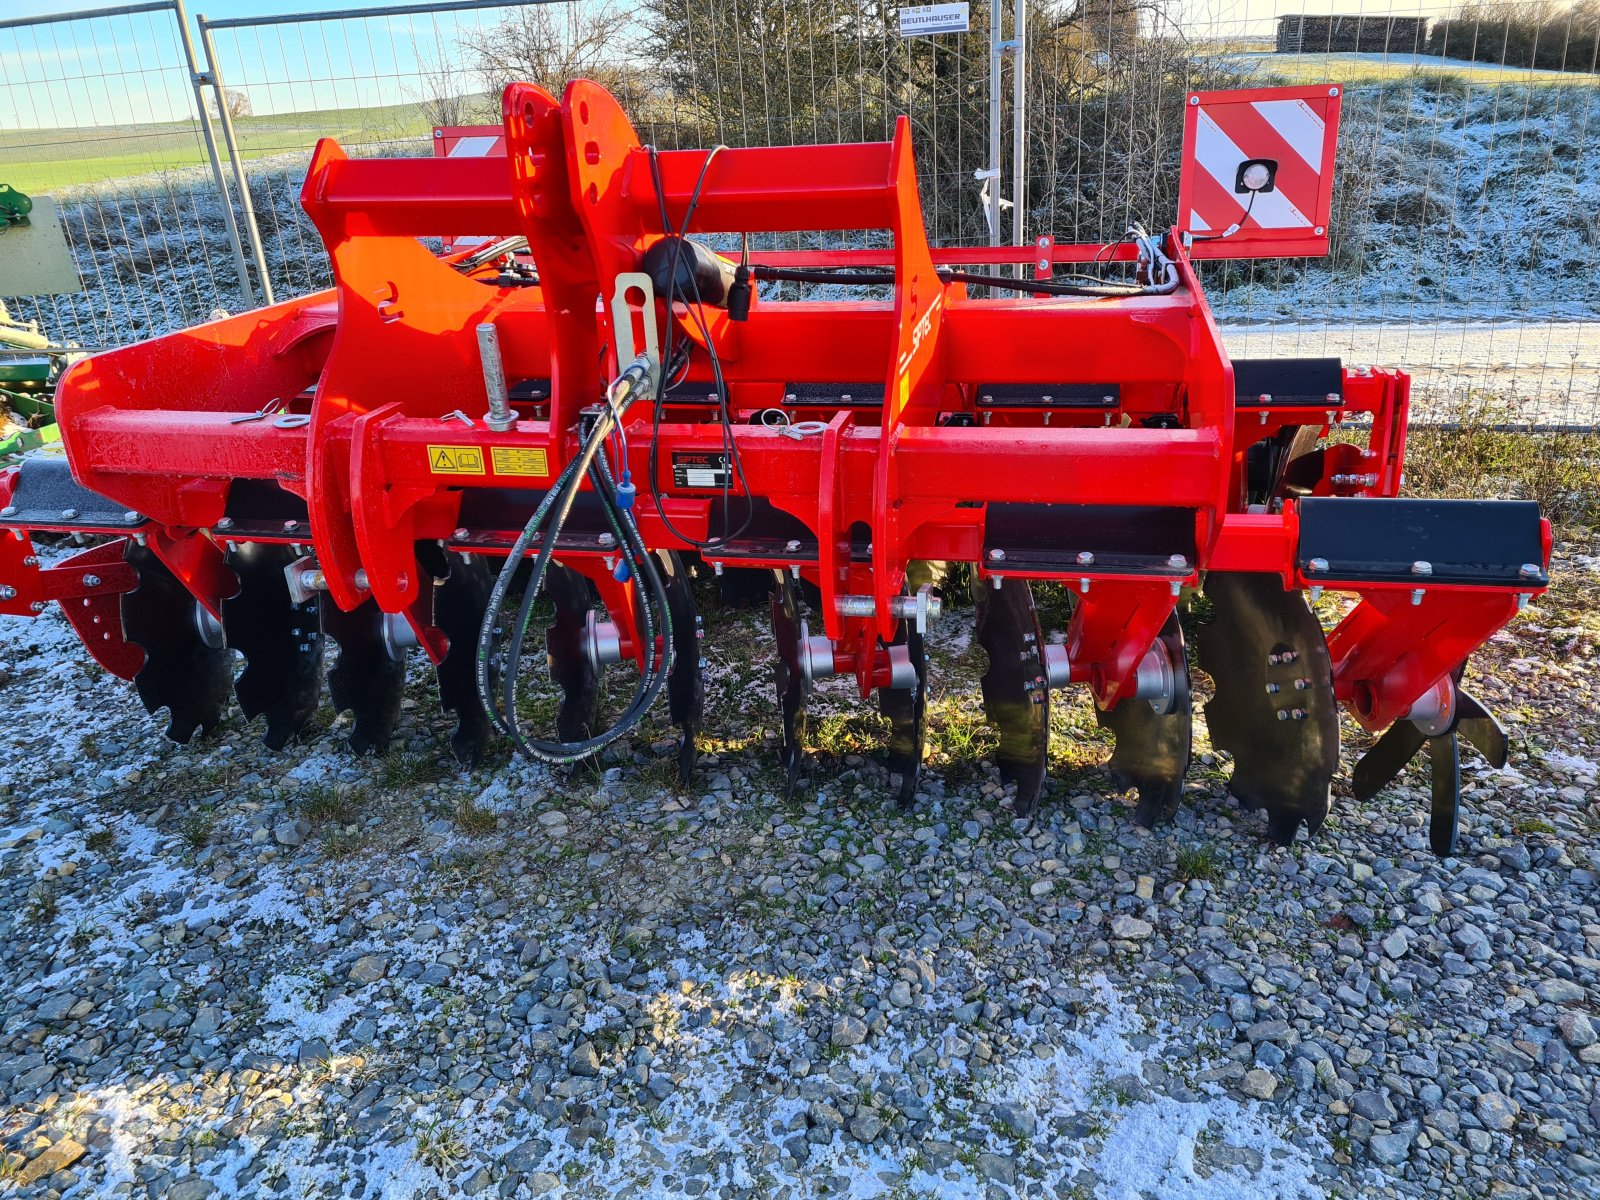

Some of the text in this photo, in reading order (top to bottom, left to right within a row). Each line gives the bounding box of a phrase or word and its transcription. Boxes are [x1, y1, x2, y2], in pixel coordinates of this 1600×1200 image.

[901, 14, 961, 25] BEUTLHAUSER
[677, 456, 709, 464] SIPTEC
[545, 495, 555, 505] EN
[550, 485, 561, 497] 853
[621, 539, 629, 549] EN
[625, 549, 633, 560] 853
[634, 572, 644, 588] DN10
[640, 591, 648, 603] SAE
[650, 642, 654, 650] WP
[481, 635, 487, 645] WP
